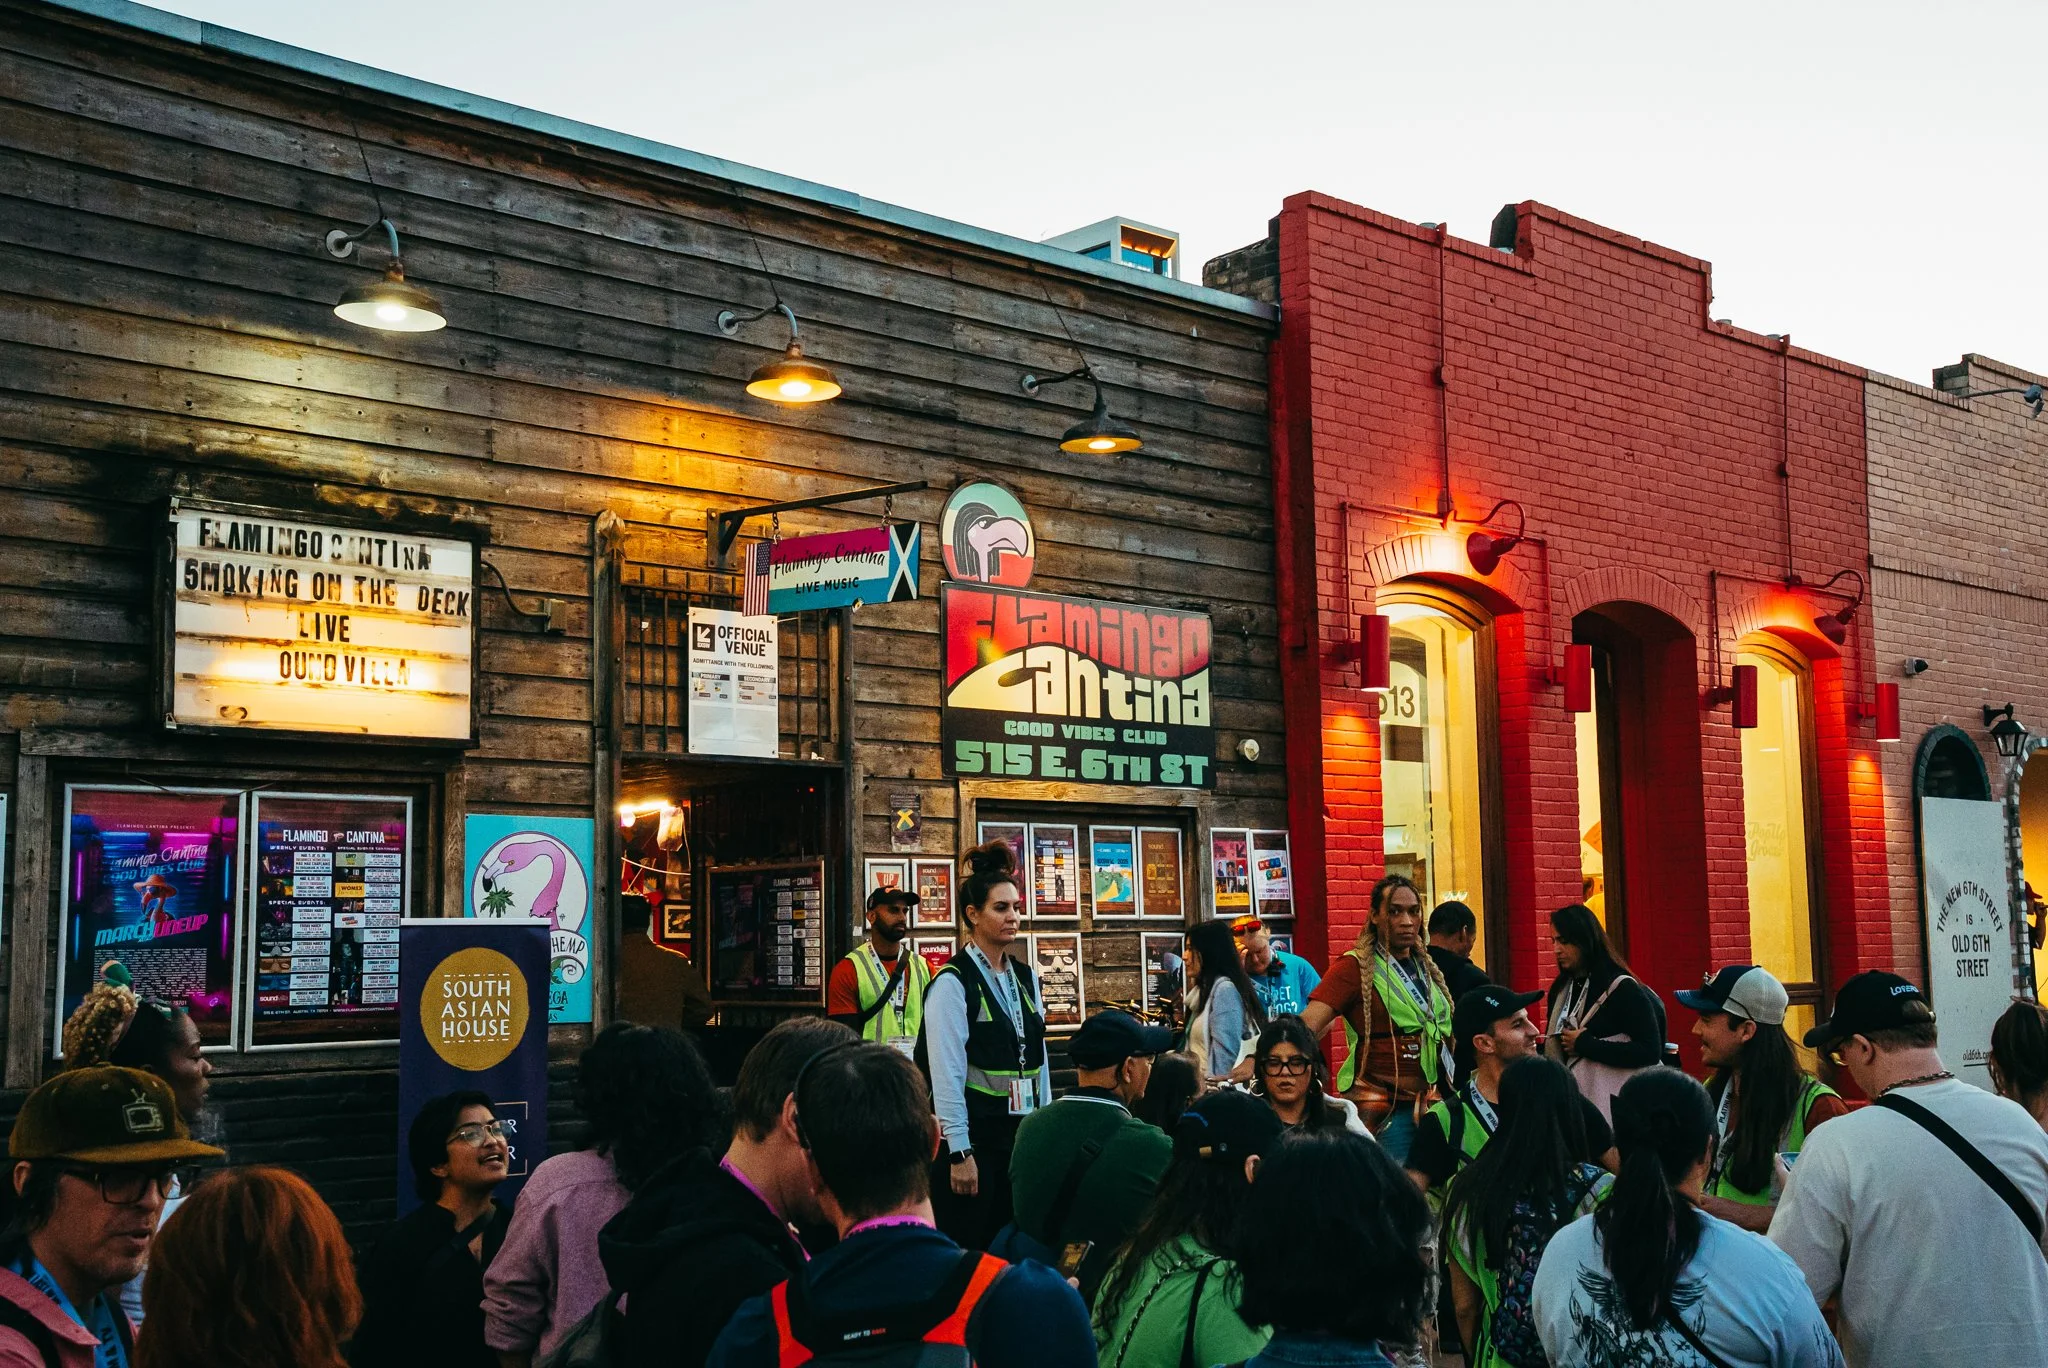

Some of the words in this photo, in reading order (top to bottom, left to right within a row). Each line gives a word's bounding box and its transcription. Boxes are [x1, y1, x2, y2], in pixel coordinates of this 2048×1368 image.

[200, 518, 322, 561] FLAMINGO
[774, 550, 830, 579] Flamingo
[834, 543, 886, 566] Cantina
[184, 558, 298, 598] SMOKING
[312, 571, 341, 601] ON
[355, 576, 396, 606] THE
[418, 586, 470, 617] DECK
[795, 581, 820, 594] LIVE
[824, 576, 860, 591] MUSIC
[299, 611, 350, 643] LIVE
[717, 625, 773, 644] OFFICIAL
[725, 640, 766, 657] VENUE
[693, 657, 723, 666] ADMITTANCE
[1004, 720, 1054, 738] GOOD
[1061, 723, 1115, 742] VIBES
[1122, 728, 1167, 746] CLUB
[955, 740, 1033, 776] 515
[1040, 745, 1076, 778] E.
[1080, 748, 1151, 783] 6TH
[1159, 753, 1209, 785] ST
[883, 874, 894, 885] UP
[1936, 907, 1950, 933] THE
[1947, 883, 1962, 908] NEW
[1963, 880, 1978, 897] 6TH
[1978, 887, 2004, 933] STREET
[1966, 914, 1974, 925] IS
[95, 916, 156, 946] MARCH
[551, 936, 585, 954] HEMP
[1952, 935, 1970, 953] OLD
[1972, 934, 1991, 953] 6TH
[1956, 958, 1989, 978] STREET
[442, 979, 511, 998] SOUTH
[441, 1000, 511, 1018] ASIAN
[442, 1018, 511, 1038] HOUSE
